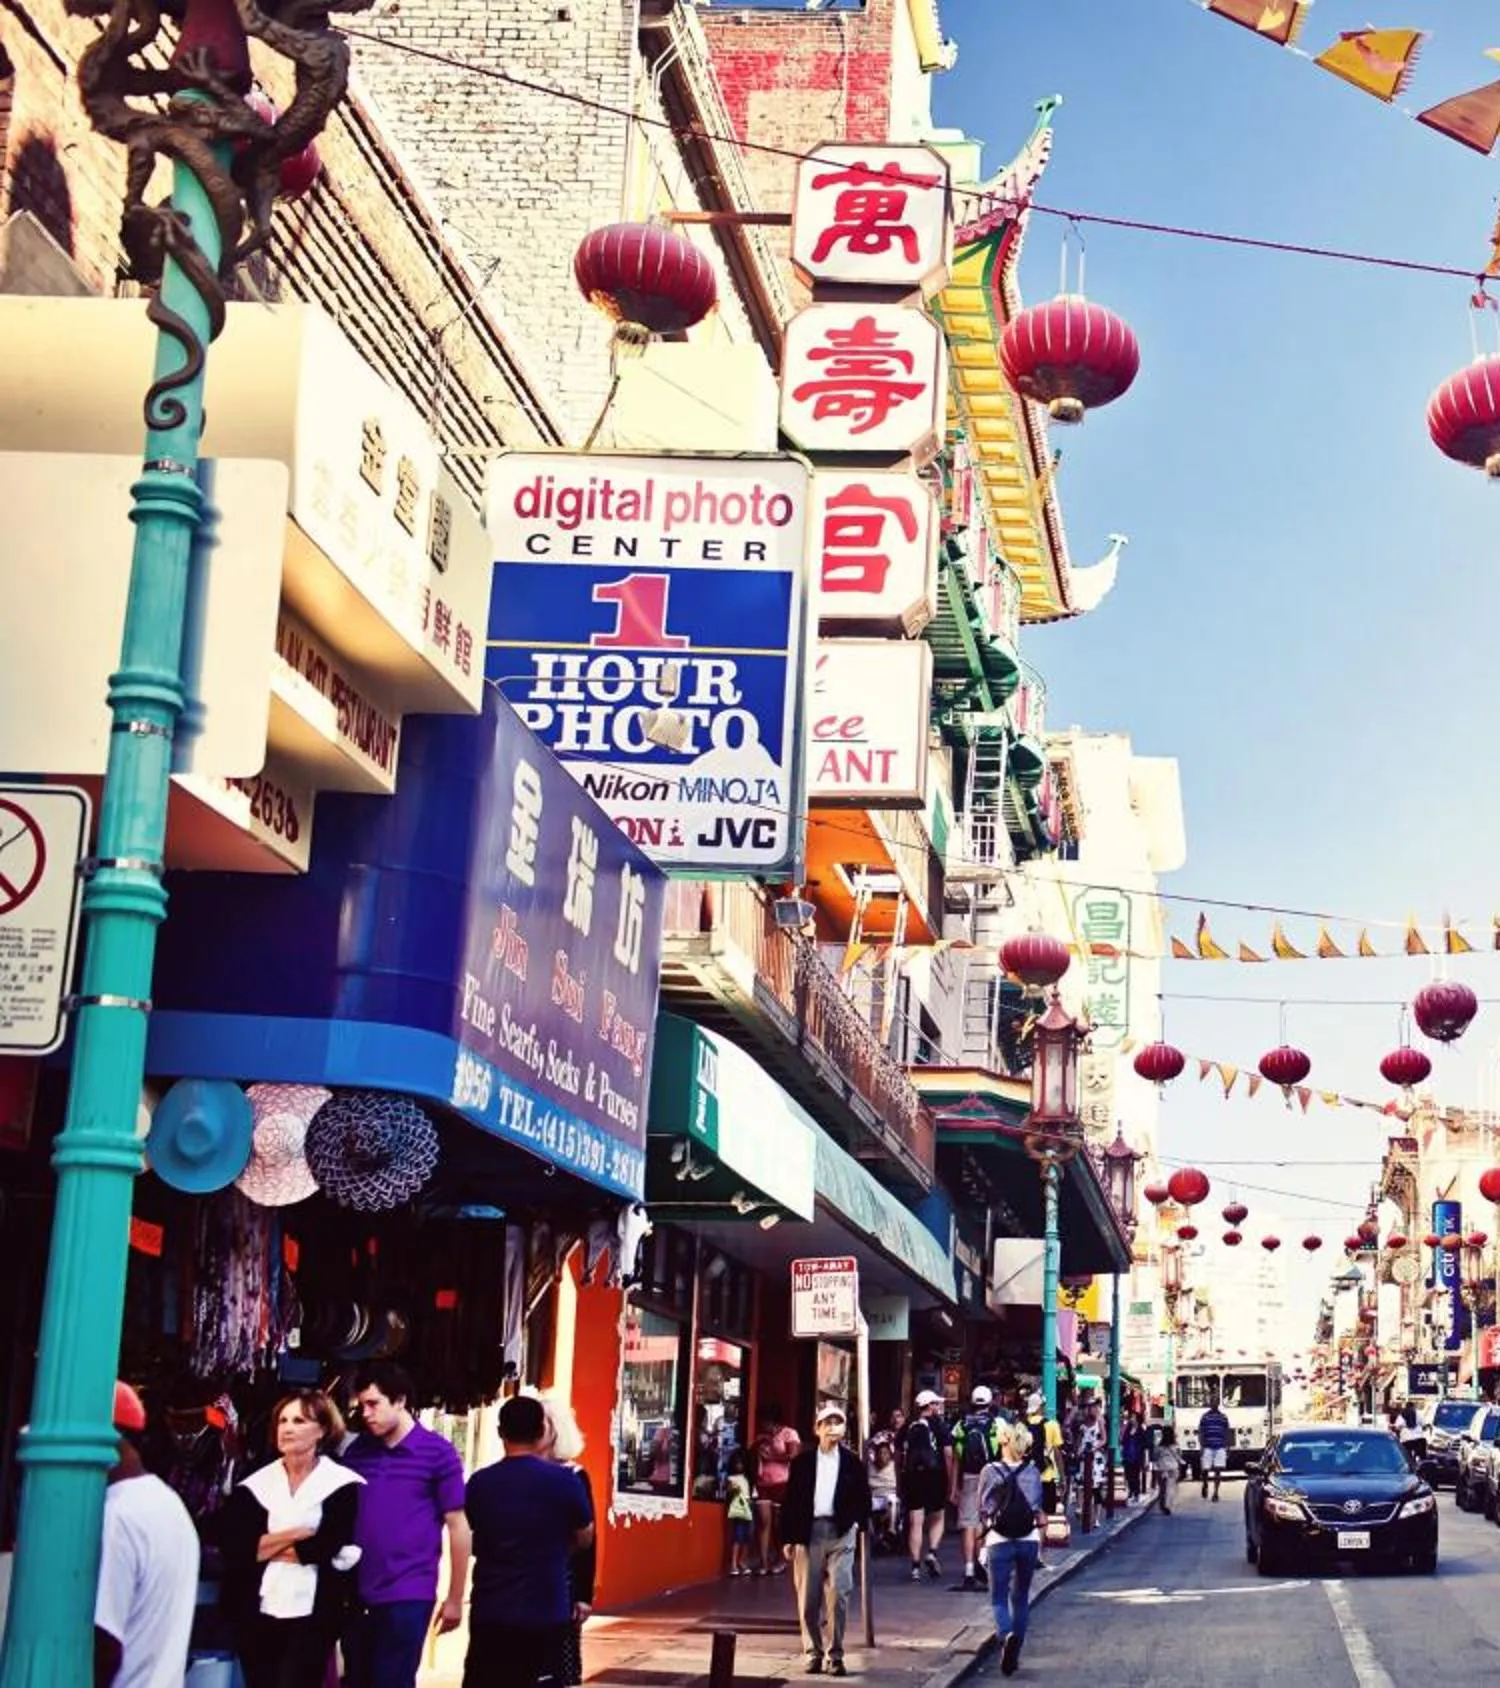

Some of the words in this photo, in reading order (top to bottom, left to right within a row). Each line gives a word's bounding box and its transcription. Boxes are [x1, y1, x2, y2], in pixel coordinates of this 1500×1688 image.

[514, 476, 653, 529] digital
[663, 484, 793, 531] photo
[526, 533, 767, 561] CENTER
[590, 573, 690, 649] 1
[528, 653, 742, 706] HOUR
[511, 702, 759, 755] PHOTO
[583, 773, 669, 802] Nikon
[698, 817, 777, 849] JVC
[461, 971, 496, 1038] Fine
[499, 1001, 546, 1080] Scarfs,
[545, 1038, 580, 1095] Socks
[584, 1061, 597, 1102] &
[598, 1070, 639, 1131] Purses
[794, 1273, 812, 1290] NO
[811, 1307, 837, 1320] TIME
[813, 1293, 837, 1305] ANY
